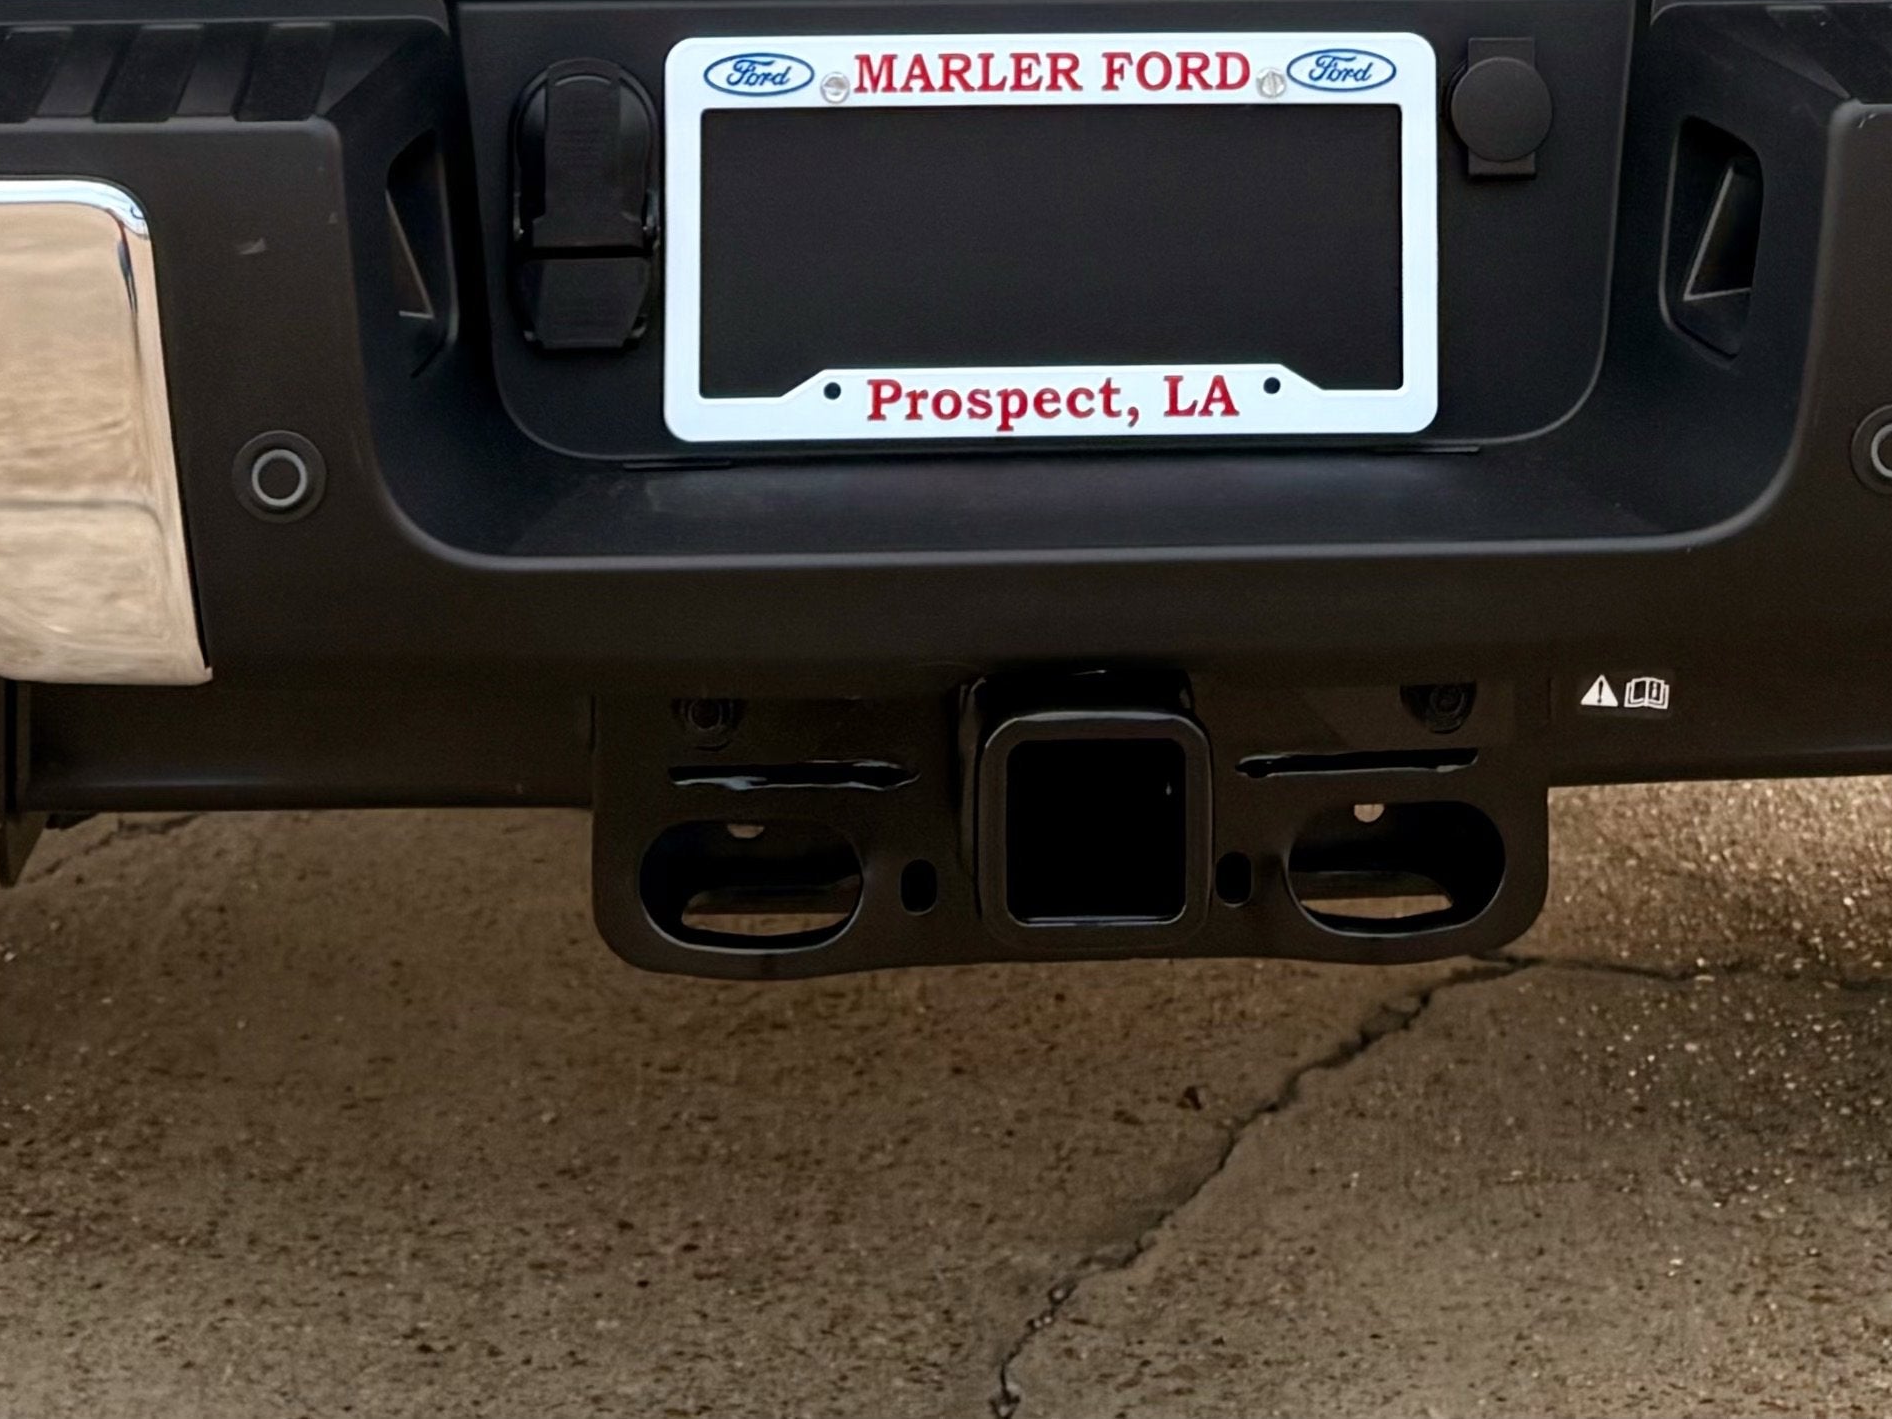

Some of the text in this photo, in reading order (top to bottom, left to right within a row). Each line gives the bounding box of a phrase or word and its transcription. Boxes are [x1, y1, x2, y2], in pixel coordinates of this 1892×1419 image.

[725, 59, 792, 87] Ford
[854, 51, 1251, 93] MARLER FORD
[1308, 54, 1374, 82] Ford
[866, 374, 1240, 432] Prospect, LA
